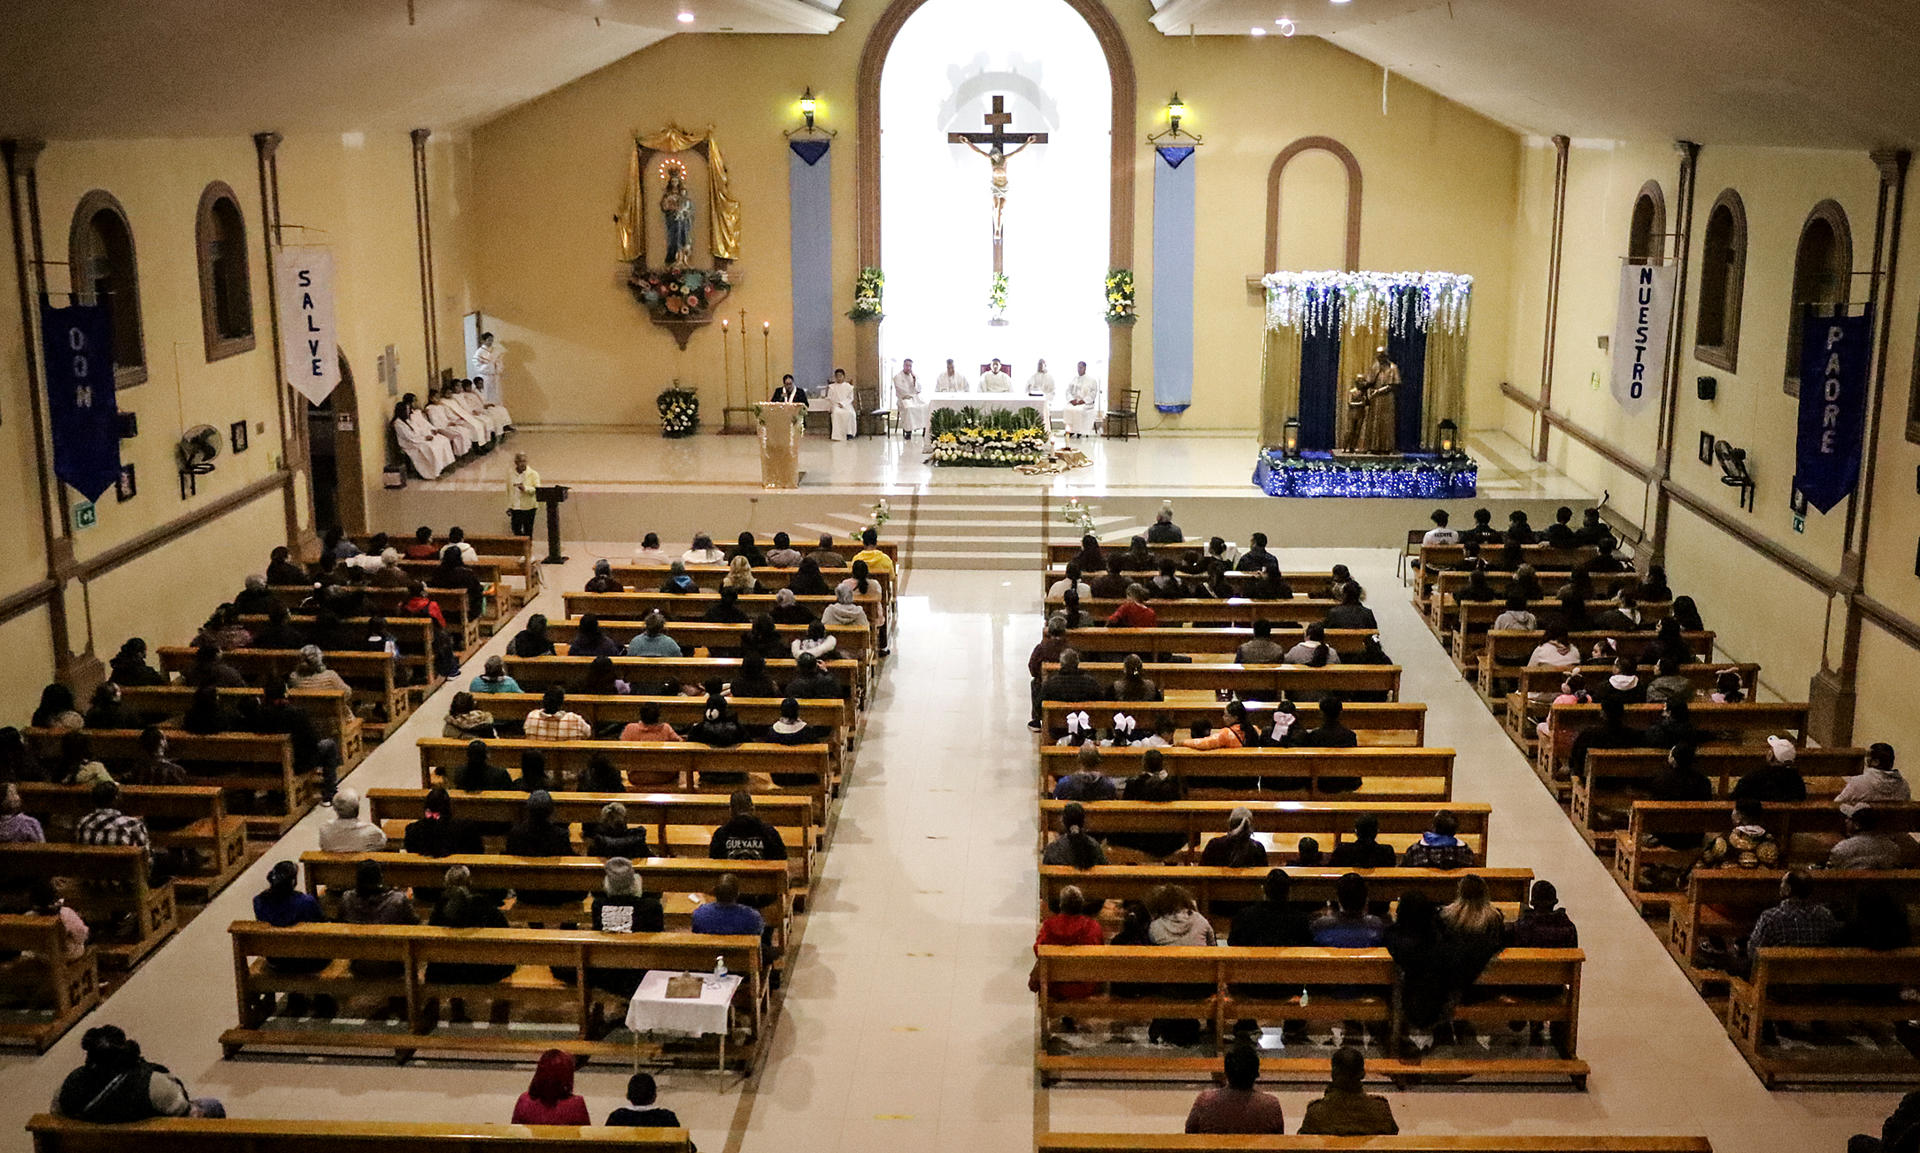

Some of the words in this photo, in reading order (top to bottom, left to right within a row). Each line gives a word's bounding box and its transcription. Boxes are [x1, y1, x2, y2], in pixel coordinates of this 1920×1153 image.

[69, 327, 92, 408] DON
[298, 270, 323, 376] SALVE
[1630, 267, 1652, 399] NUESTRO
[1820, 326, 1844, 453] PADRE
[725, 839, 764, 849] GUEVARA
